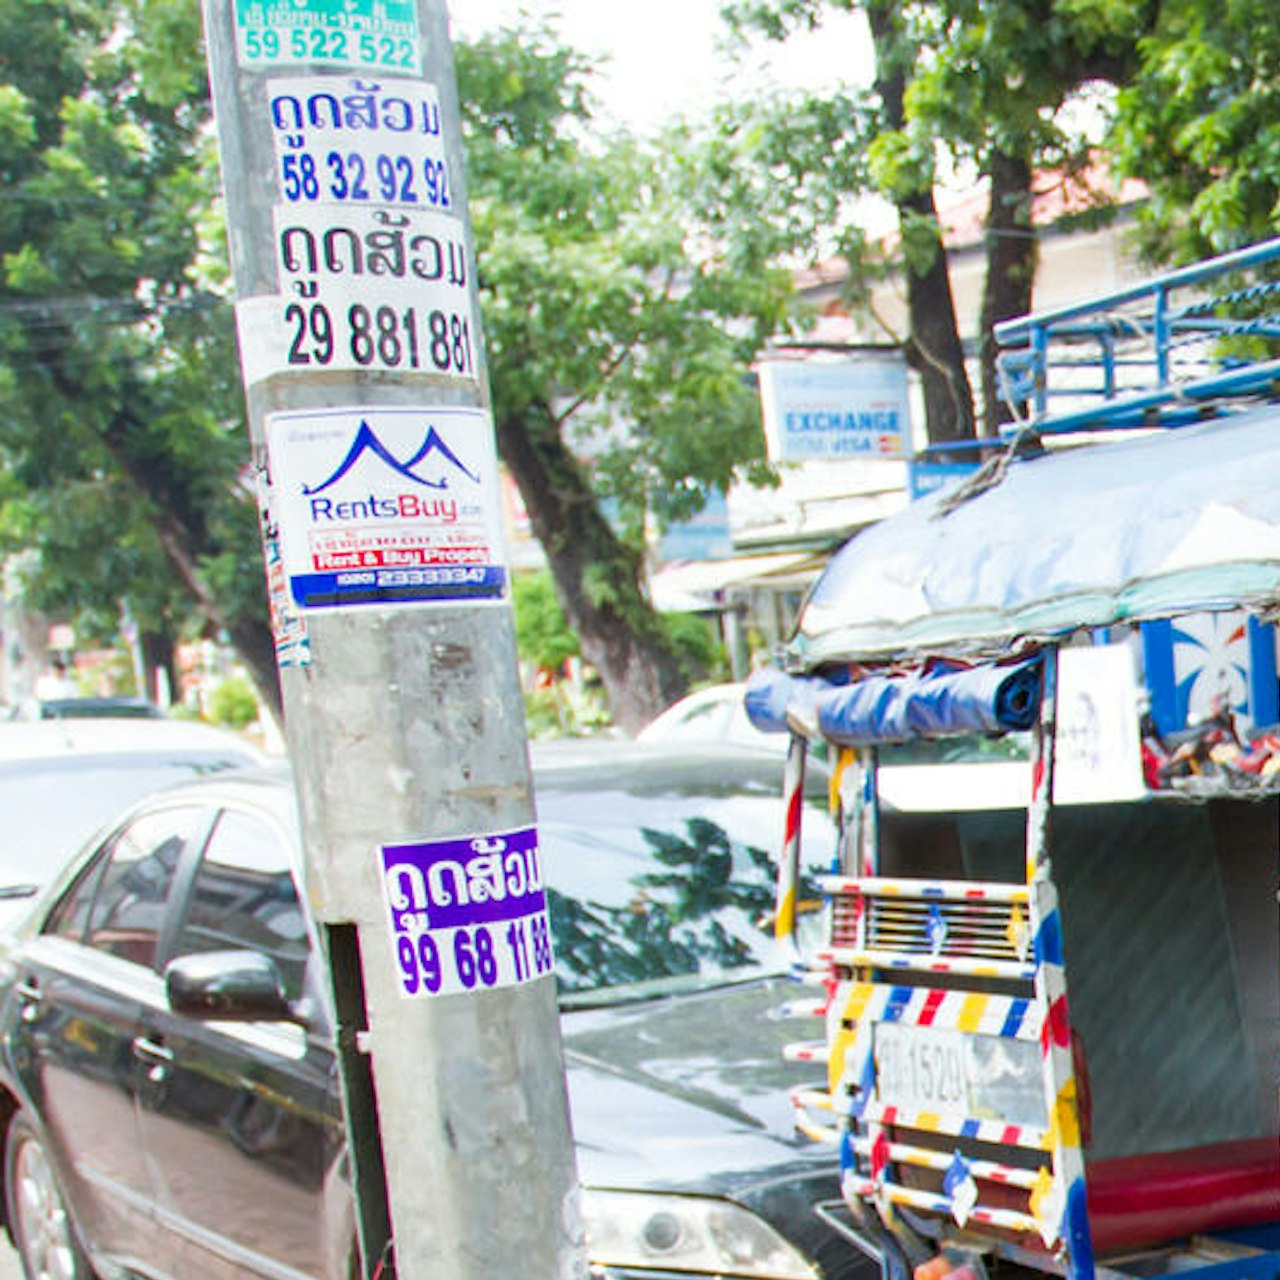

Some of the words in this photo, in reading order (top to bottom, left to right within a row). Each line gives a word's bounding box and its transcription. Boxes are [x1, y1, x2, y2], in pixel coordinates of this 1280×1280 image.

[246, 30, 279, 58] 59
[291, 30, 348, 59] 522
[360, 35, 415, 67] 522
[283, 153, 319, 201] 58
[327, 151, 369, 199] 32
[376, 154, 418, 202] 92
[285, 303, 334, 365] 29
[348, 303, 420, 368] 881
[785, 410, 901, 432] EXCHANGE
[398, 934, 441, 993] 99
[454, 927, 497, 988] 68
